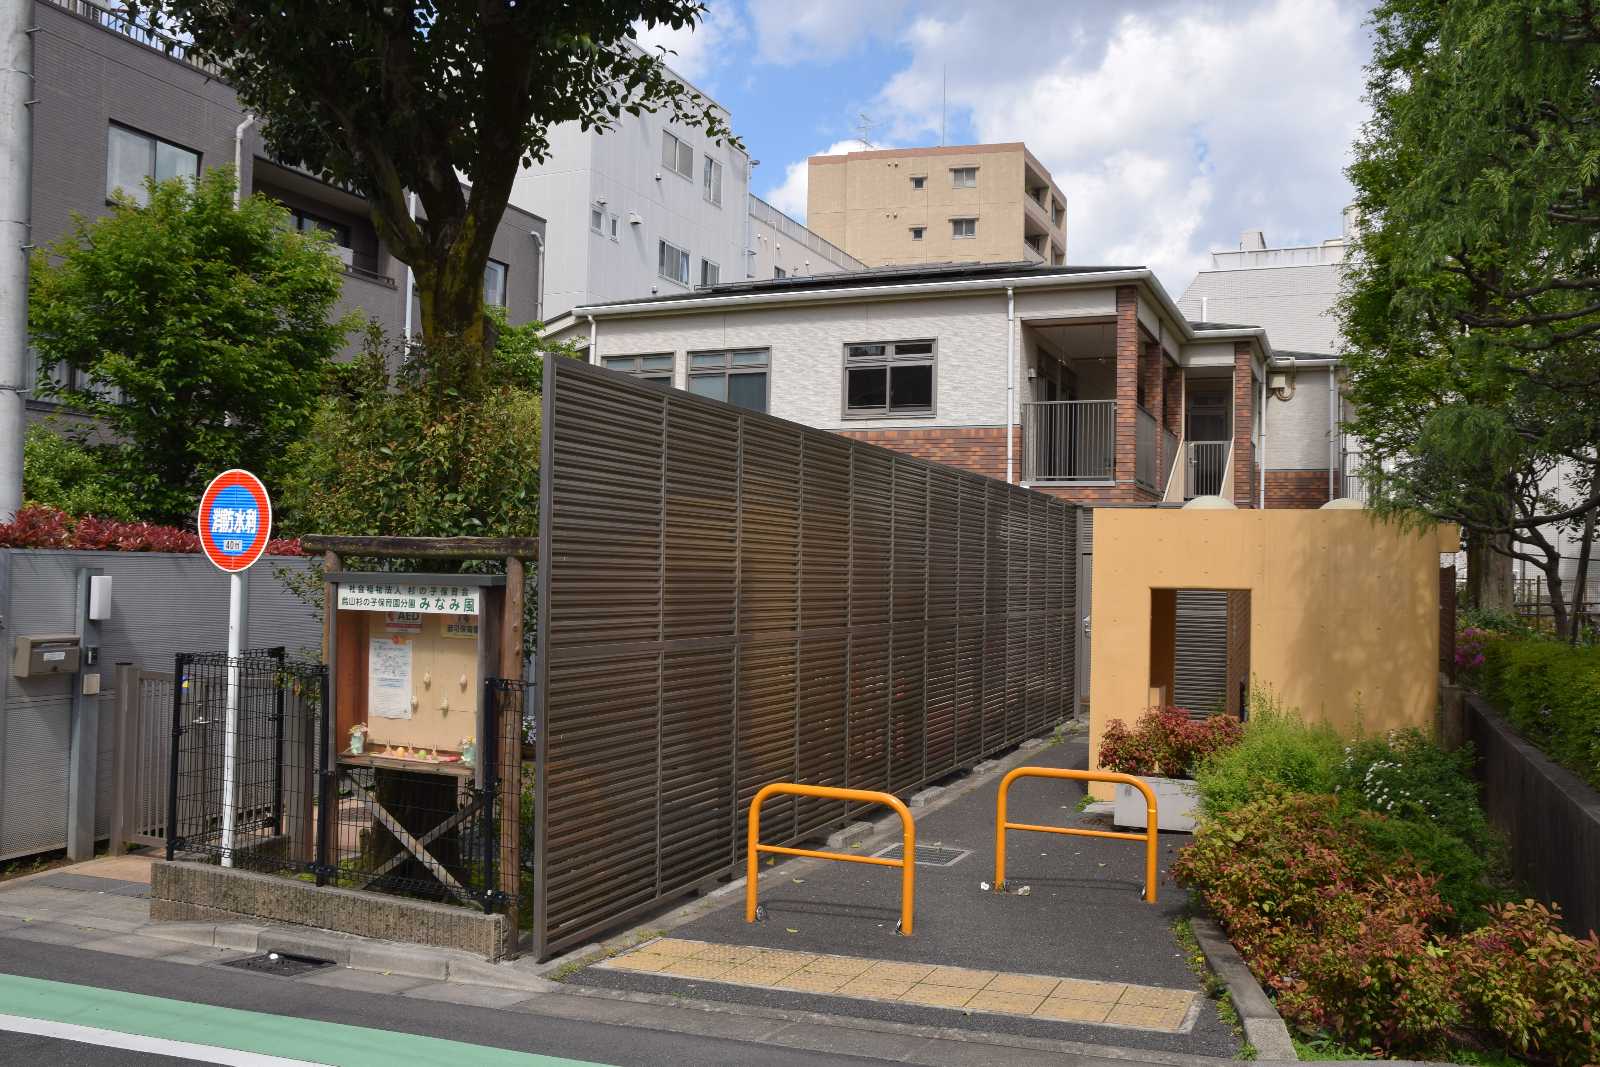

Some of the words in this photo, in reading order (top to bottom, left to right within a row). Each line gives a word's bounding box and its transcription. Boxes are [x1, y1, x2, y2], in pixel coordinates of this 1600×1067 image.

[211, 507, 257, 534] 消防水利
[225, 540, 240, 550] 40m
[349, 584, 401, 594] 社会福祉法人
[398, 611, 420, 620] AED
